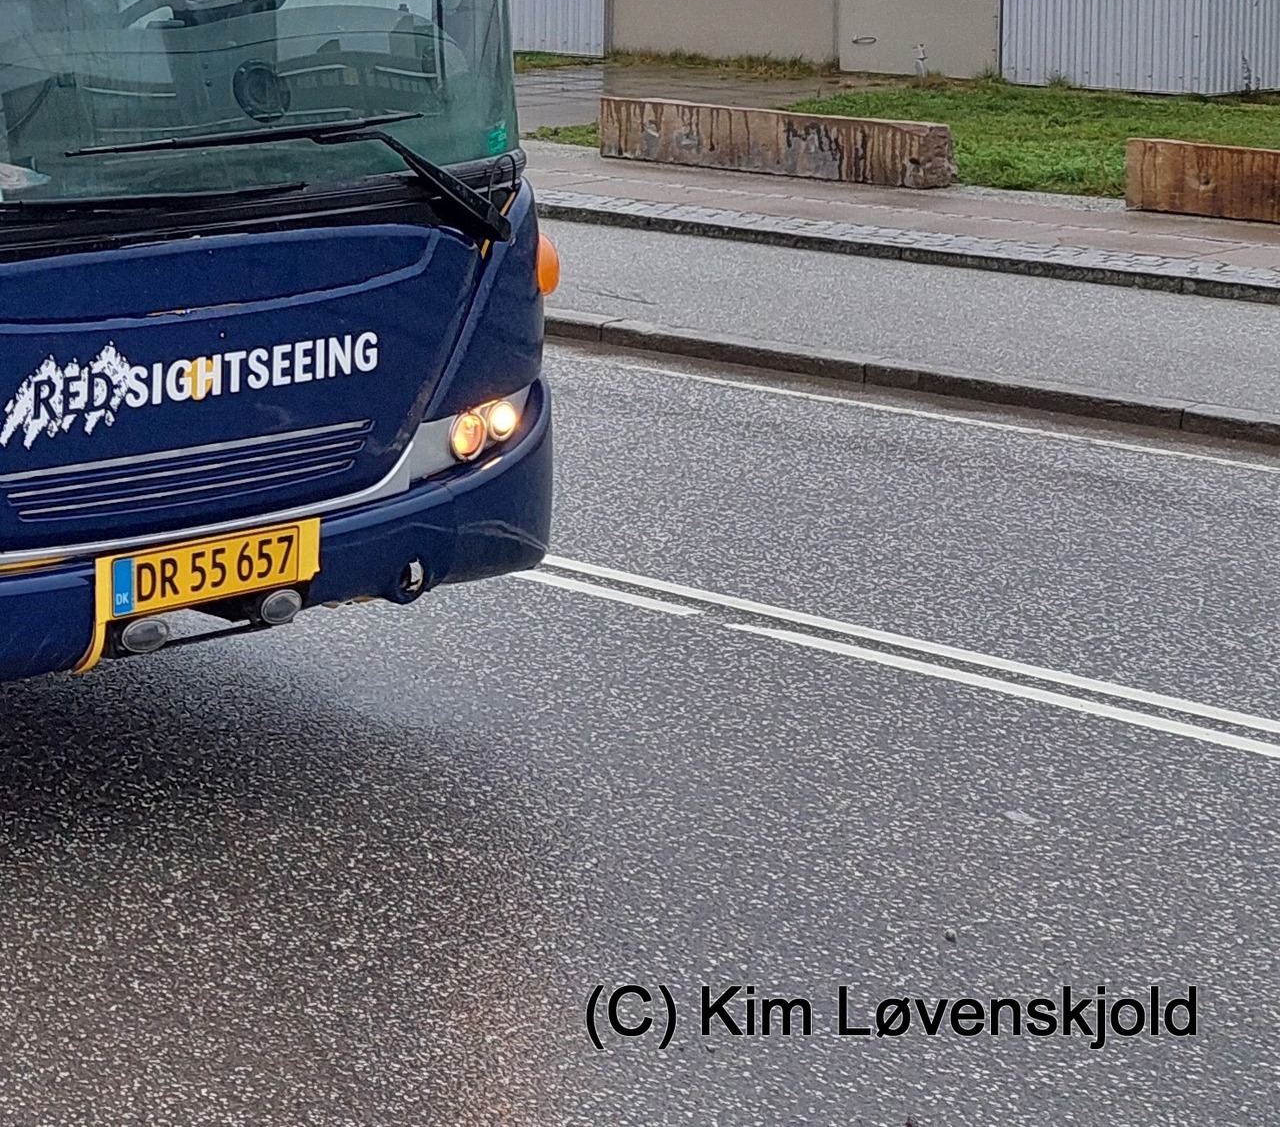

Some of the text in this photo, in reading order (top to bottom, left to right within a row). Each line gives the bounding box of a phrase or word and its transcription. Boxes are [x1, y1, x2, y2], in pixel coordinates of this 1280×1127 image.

[124, 331, 379, 408] SIGHTSEEING
[115, 592, 129, 605] DK
[136, 535, 295, 603] DR 55 657
